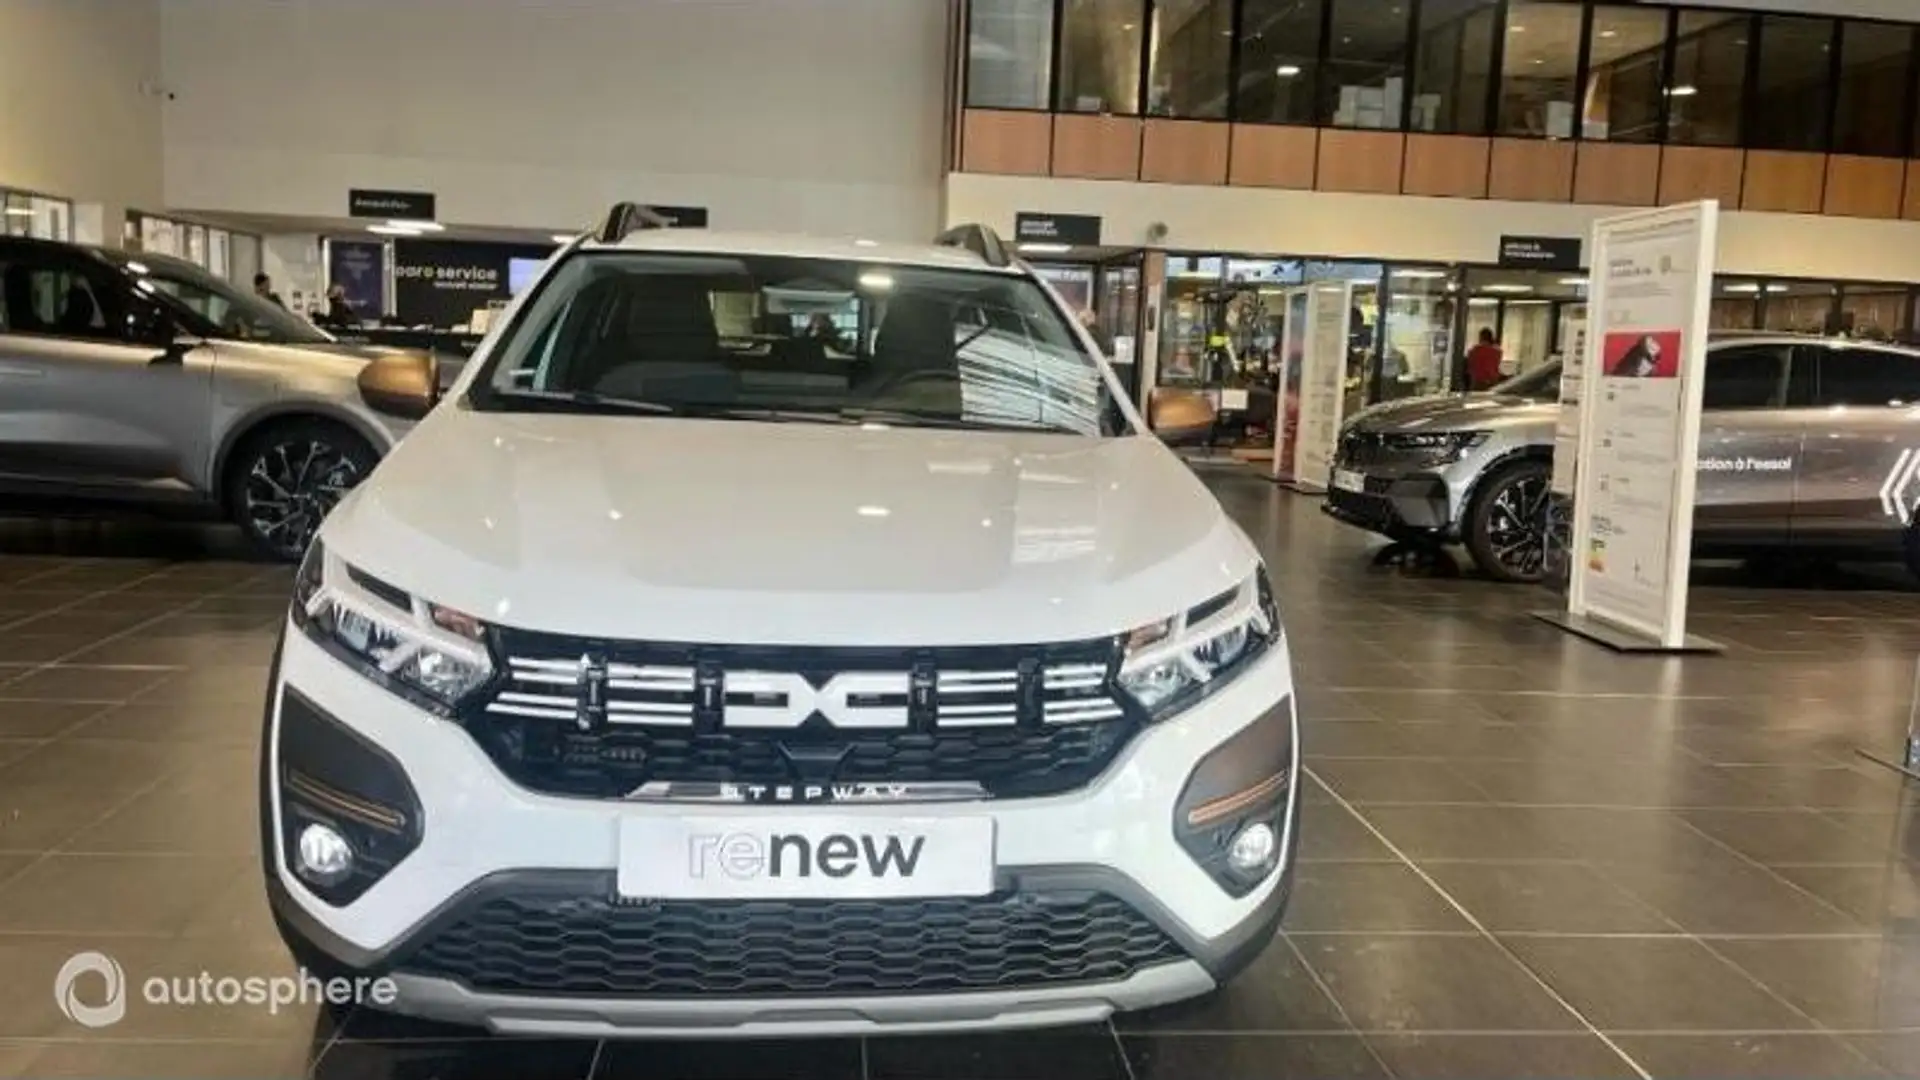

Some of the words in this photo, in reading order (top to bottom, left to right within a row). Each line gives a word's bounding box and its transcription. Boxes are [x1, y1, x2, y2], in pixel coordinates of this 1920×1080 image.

[436, 265, 498, 280] service
[719, 782, 908, 801] STEPWAY
[687, 832, 926, 879] renew
